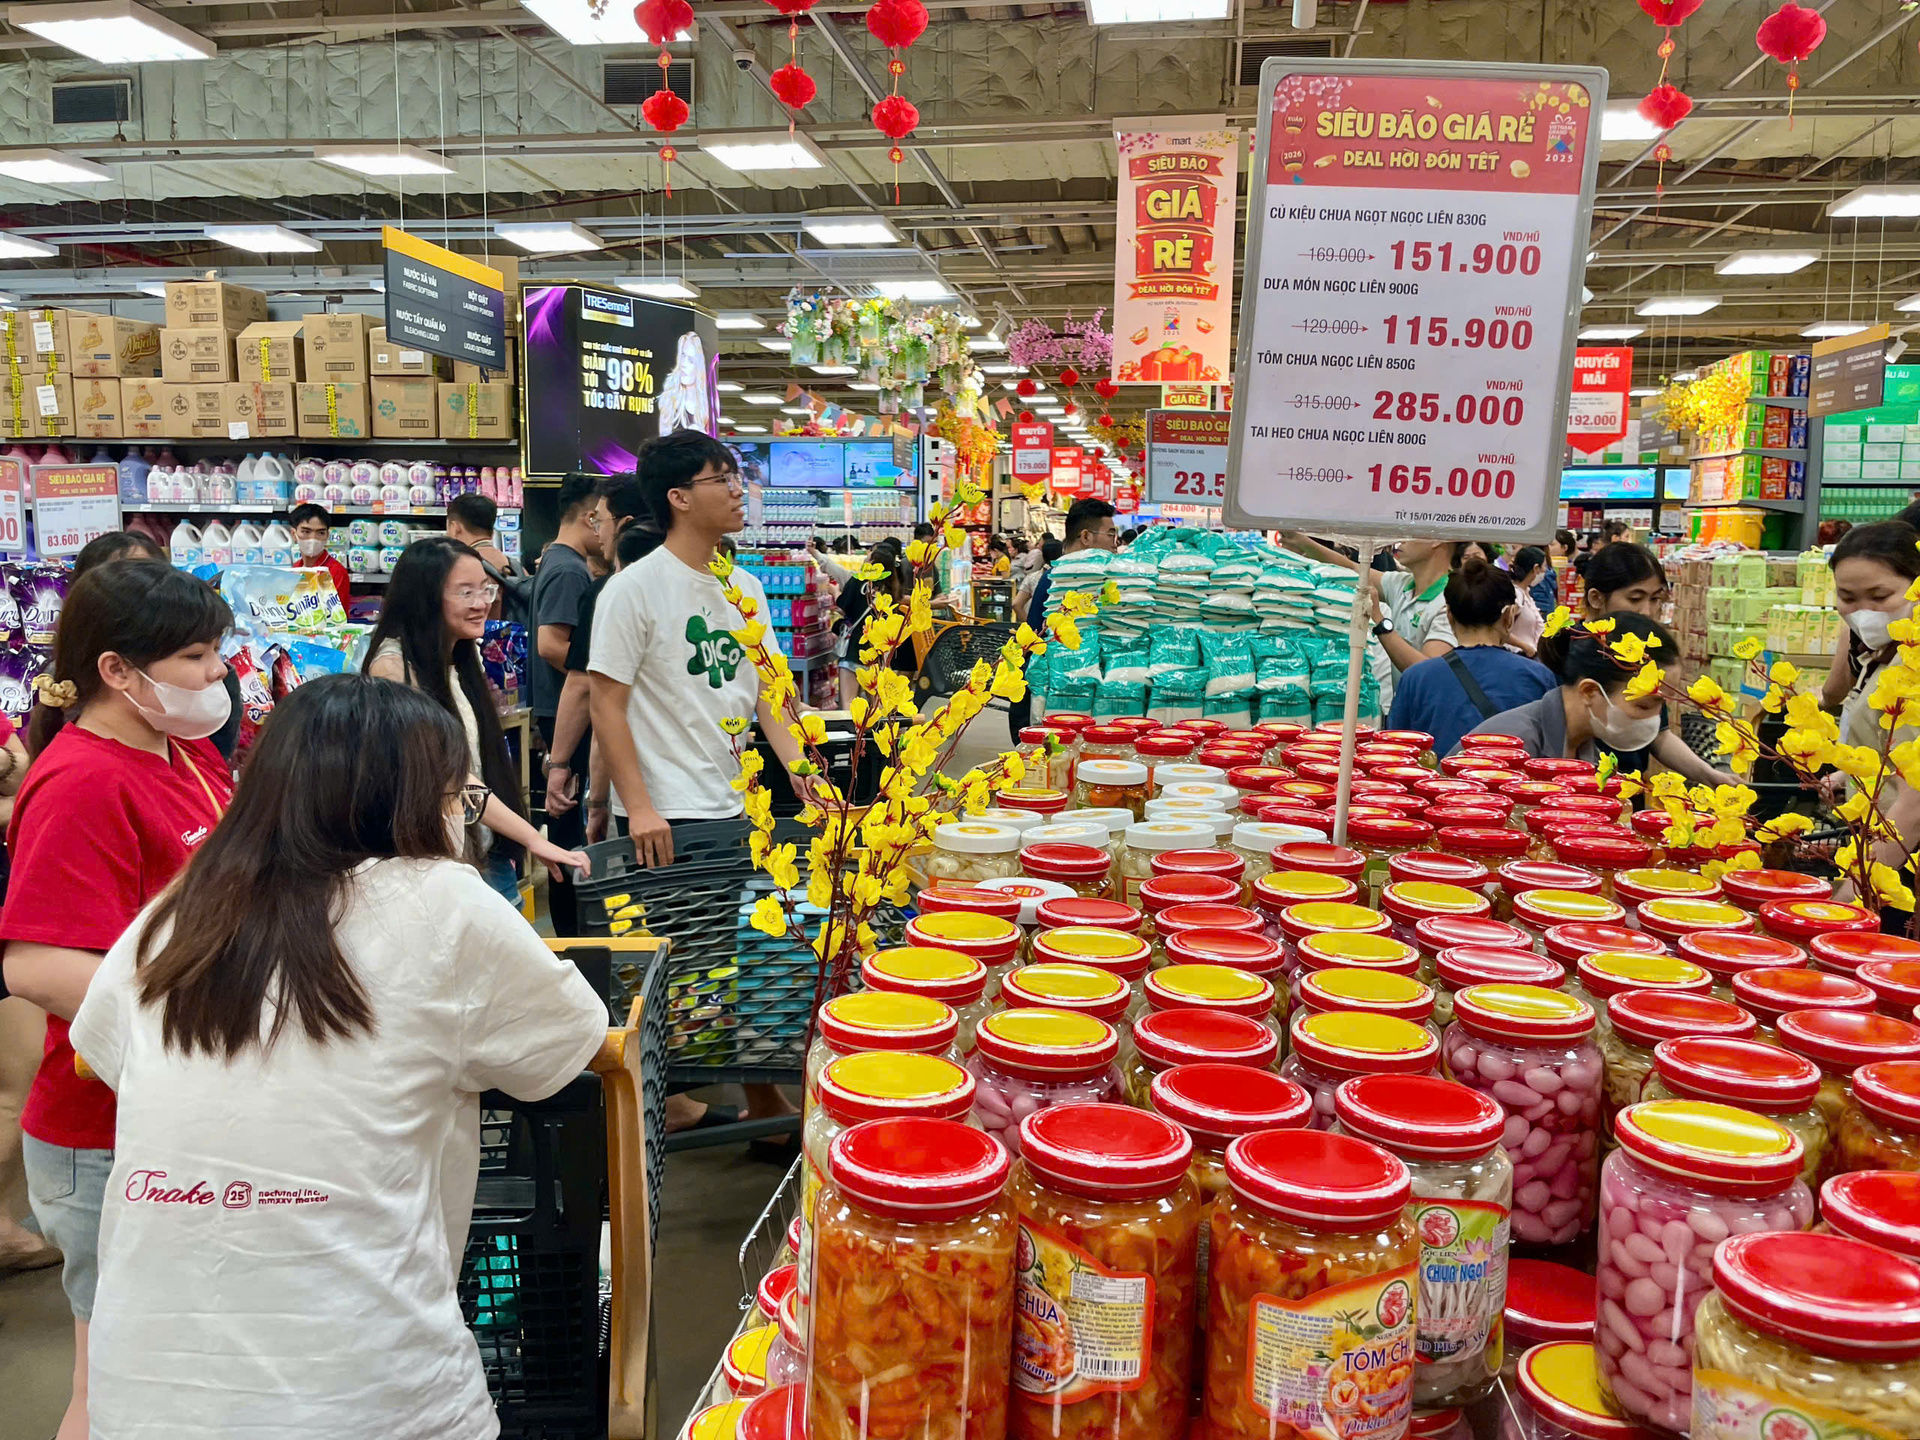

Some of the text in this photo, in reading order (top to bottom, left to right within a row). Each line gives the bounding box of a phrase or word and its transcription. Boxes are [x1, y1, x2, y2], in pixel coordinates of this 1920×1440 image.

[1316, 107, 1536, 143] SIÊU BÃO GIÁ RẺ
[1166, 136, 1192, 146] emart
[1148, 155, 1208, 172] SIÊU BÃO
[1283, 151, 1303, 160] 2026
[1343, 148, 1501, 172] DEAL HỜI ĐÓN TẾT
[1545, 153, 1574, 163] 2025
[1146, 185, 1204, 220] GIÁ
[1270, 204, 1487, 227] CỦ KIỆU CHUA NGỌT NGỌC LIÊN 830G
[1503, 231, 1540, 242] VND/HŨ
[1153, 233, 1194, 270] RẺ
[1309, 240, 1541, 276] 169.000 151.900
[1138, 285, 1158, 295] DEAL
[1263, 277, 1419, 296] DƯA MÓN NGỌC LIÊN 900G
[585, 294, 630, 313] TRESemmé
[1495, 305, 1532, 317] VND/HŨ
[1302, 314, 1533, 351] 129.000 115.900
[1257, 350, 1416, 371] TÔM CHUA NGỌC LIÊN 850G
[582, 352, 654, 395] GIẢM 98%
[582, 371, 599, 388] TỚI
[1486, 380, 1523, 392] VND/HŨ
[582, 388, 605, 408] TÓC
[1294, 390, 1524, 426] 315.000 285.000
[1250, 426, 1426, 446] TAI HEO CHUA NGỌC LIÊN 800G
[1478, 453, 1515, 465] VND/HŨ
[1288, 463, 1516, 499] 185.000 165.000
[1395, 510, 1526, 527] TỪ 15/01/2026 ĐẾN 26/01/2026
[230, 1191, 245, 1201] 25
[1016, 1288, 1059, 1324] CHUA
[1343, 1347, 1386, 1373] TÔM
